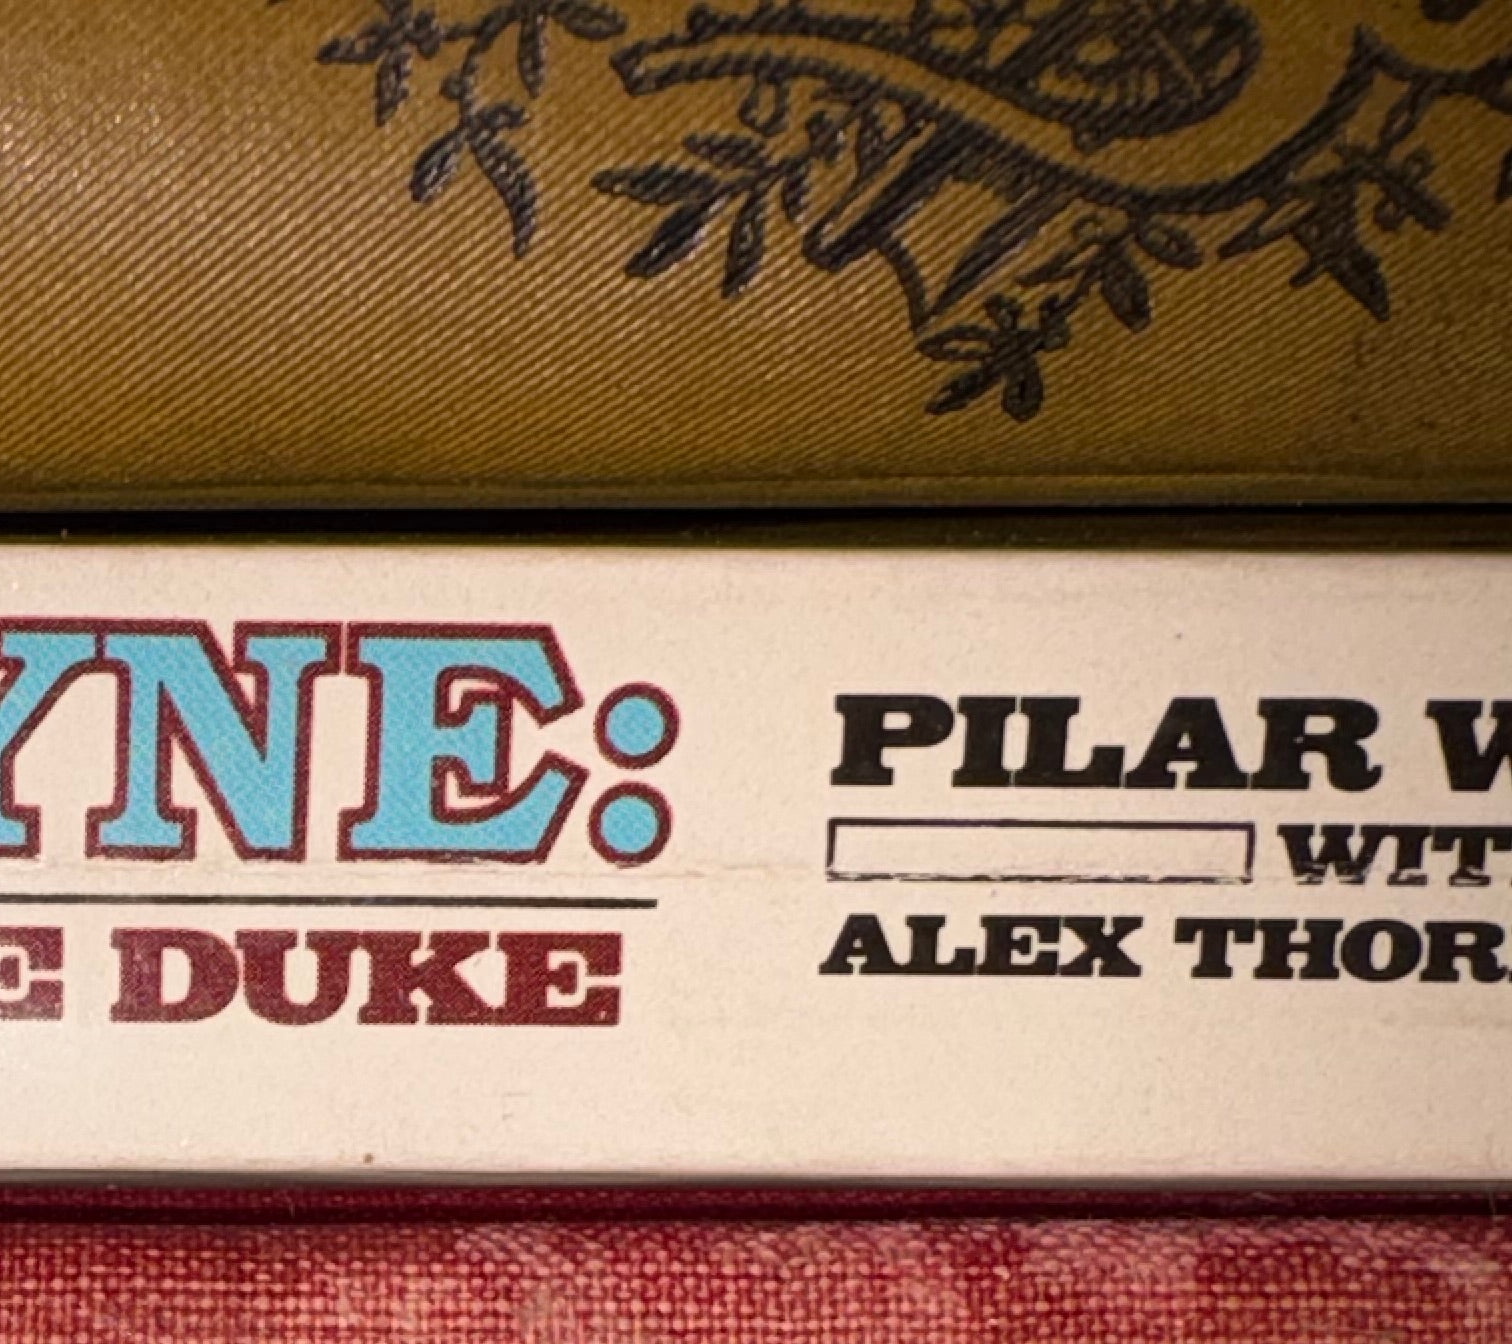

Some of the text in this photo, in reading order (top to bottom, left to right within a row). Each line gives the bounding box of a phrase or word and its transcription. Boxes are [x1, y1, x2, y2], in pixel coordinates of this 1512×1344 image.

[829, 694, 1384, 792] PILAR
[109, 928, 623, 1027] DUKE
[818, 914, 1144, 977] ALEX
